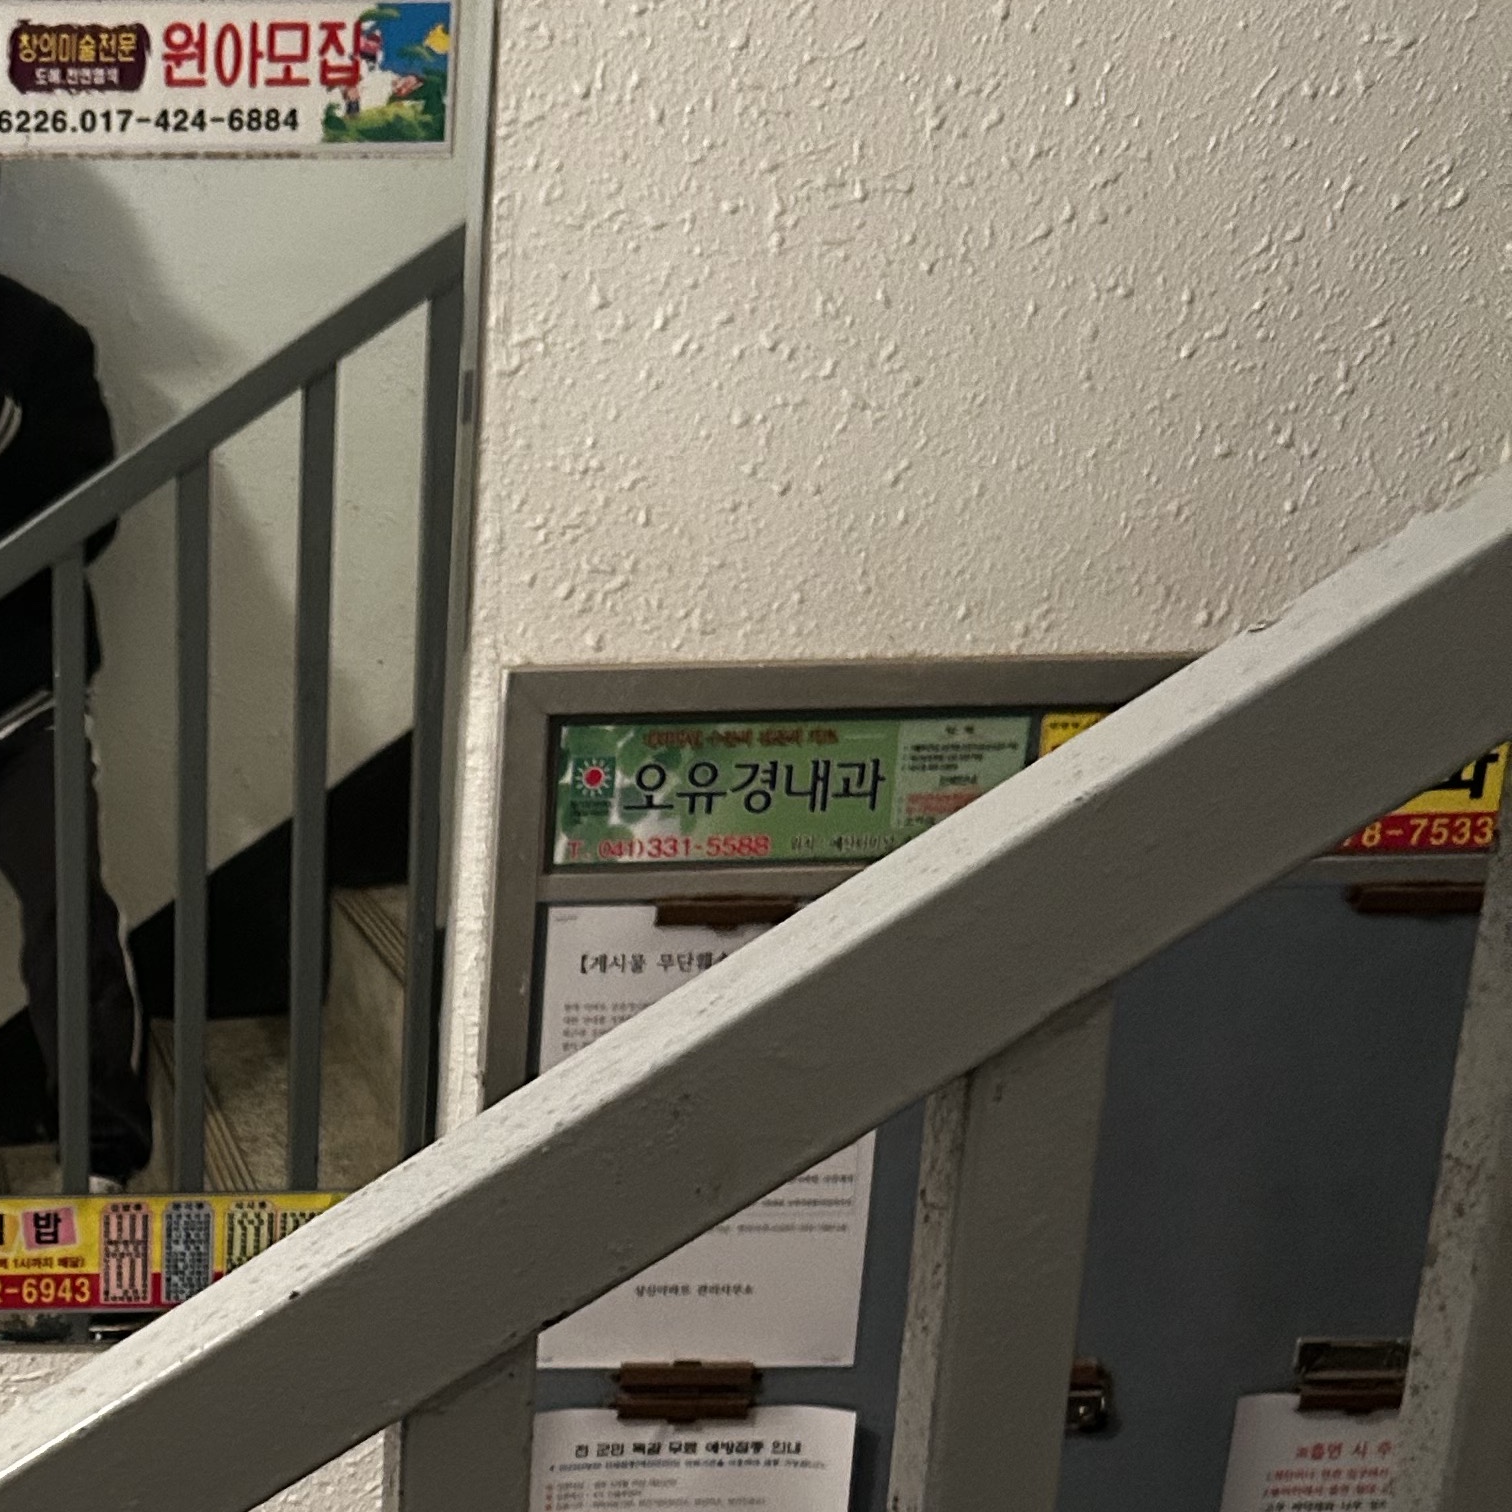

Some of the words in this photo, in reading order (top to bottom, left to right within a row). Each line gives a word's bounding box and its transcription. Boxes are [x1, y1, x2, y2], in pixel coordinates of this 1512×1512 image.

[18, 32, 138, 63] 창의미술전문
[162, 20, 362, 88] 원아모집
[624, 758, 886, 815] 오유경내과
